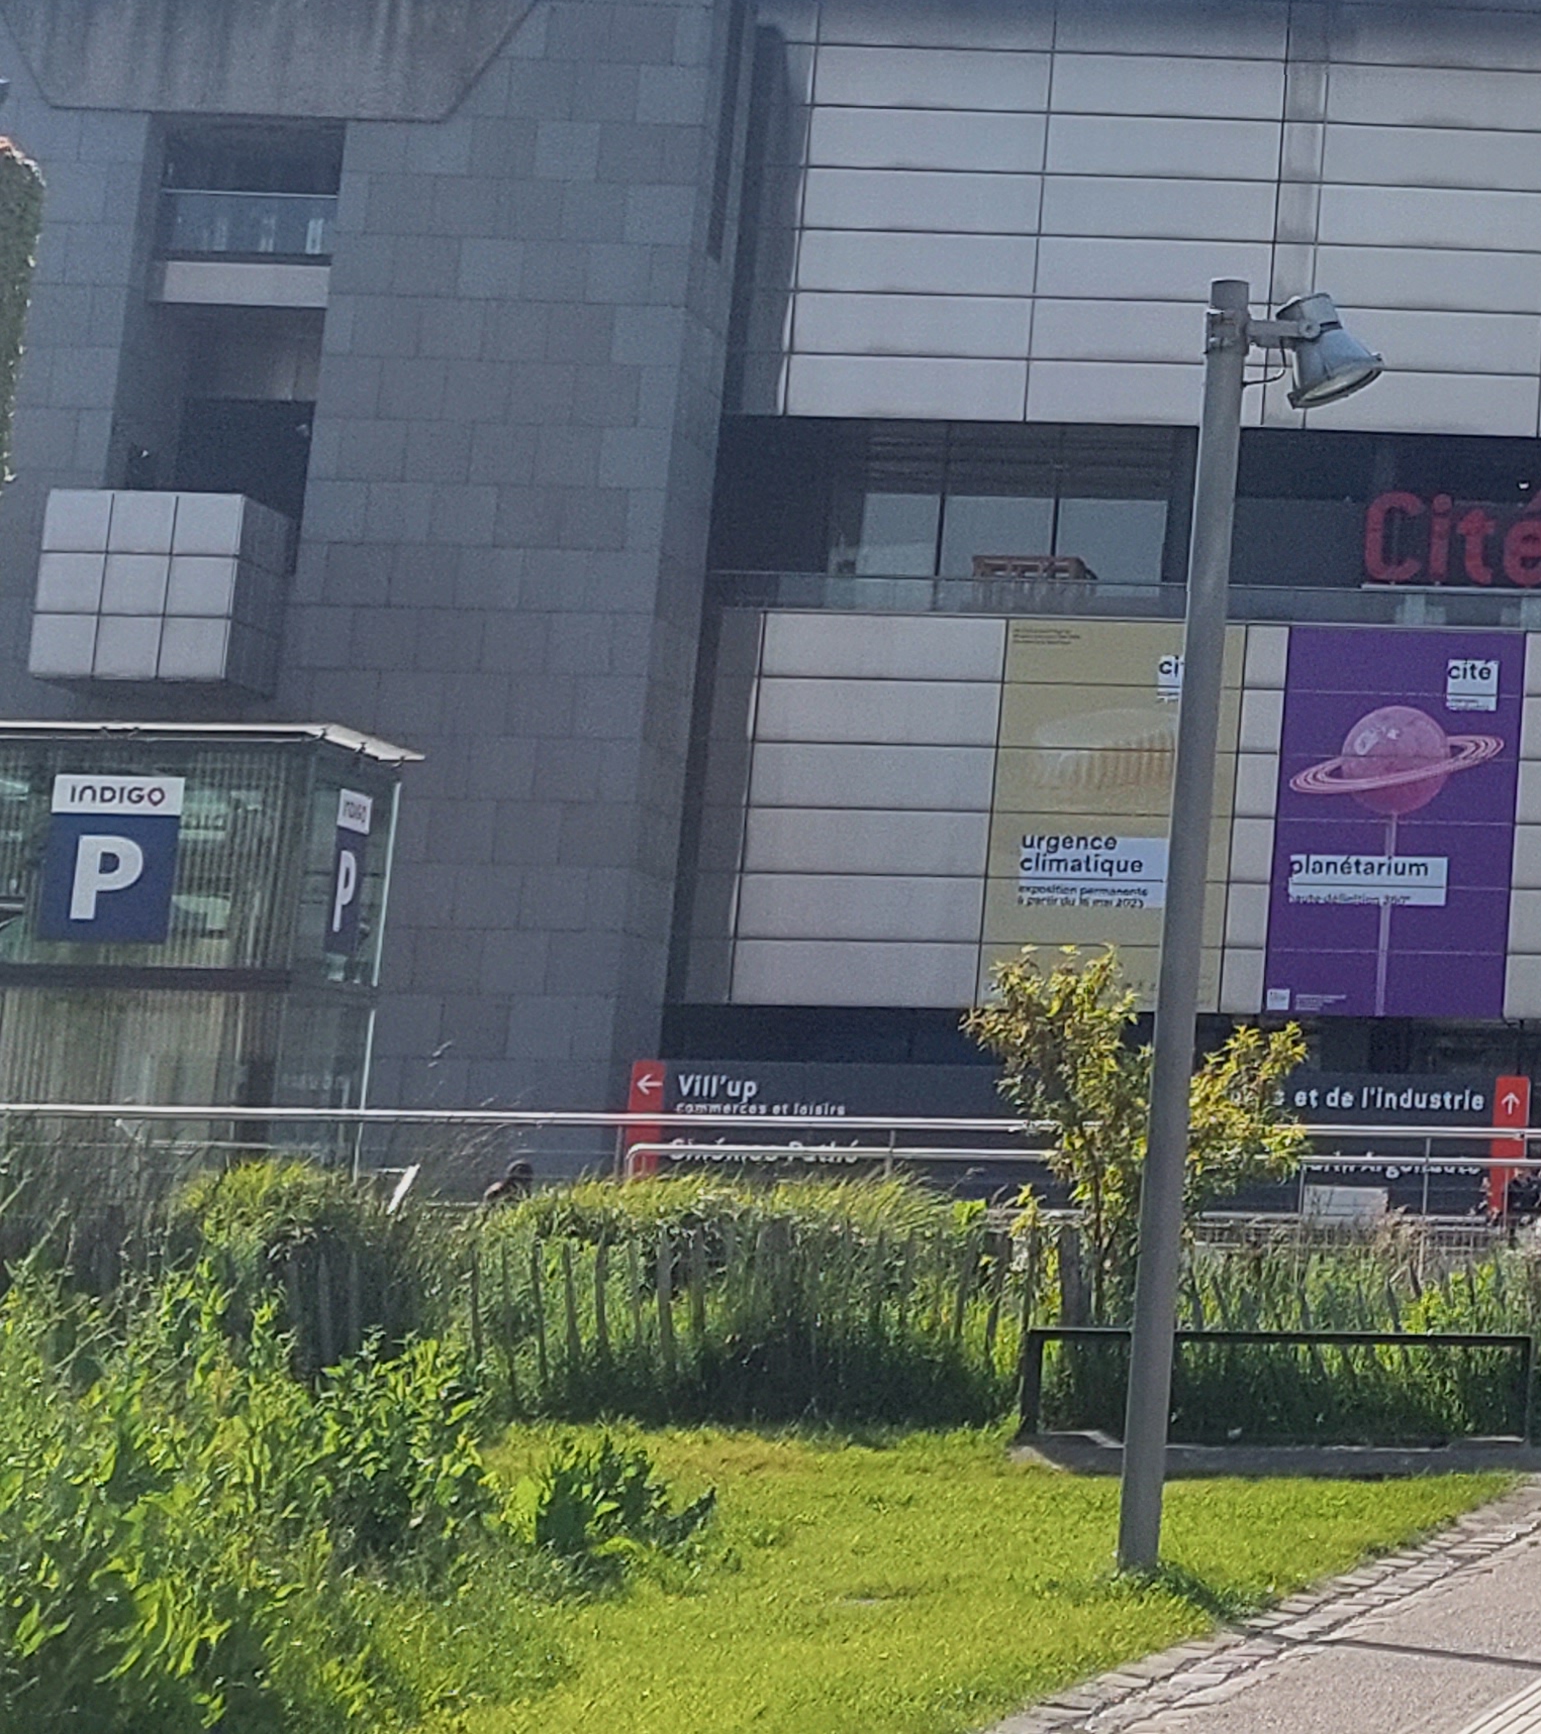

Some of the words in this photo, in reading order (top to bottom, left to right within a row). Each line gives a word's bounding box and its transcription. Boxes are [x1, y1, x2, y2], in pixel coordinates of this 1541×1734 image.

[1448, 658, 1491, 680] cité
[70, 785, 165, 806] INDIGO
[1022, 835, 1118, 854] urgence
[1020, 853, 1144, 876] climatique
[1291, 854, 1429, 876] planétarium
[70, 835, 143, 919] P
[333, 850, 357, 932] P
[679, 1074, 758, 1104] Vill'up
[1295, 1087, 1319, 1109] et
[1327, 1086, 1355, 1109] de
[1362, 1086, 1485, 1111] l'industrie
[676, 1102, 767, 1115] commerces
[772, 1103, 788, 1115] et
[794, 1102, 846, 1116] loisirs
